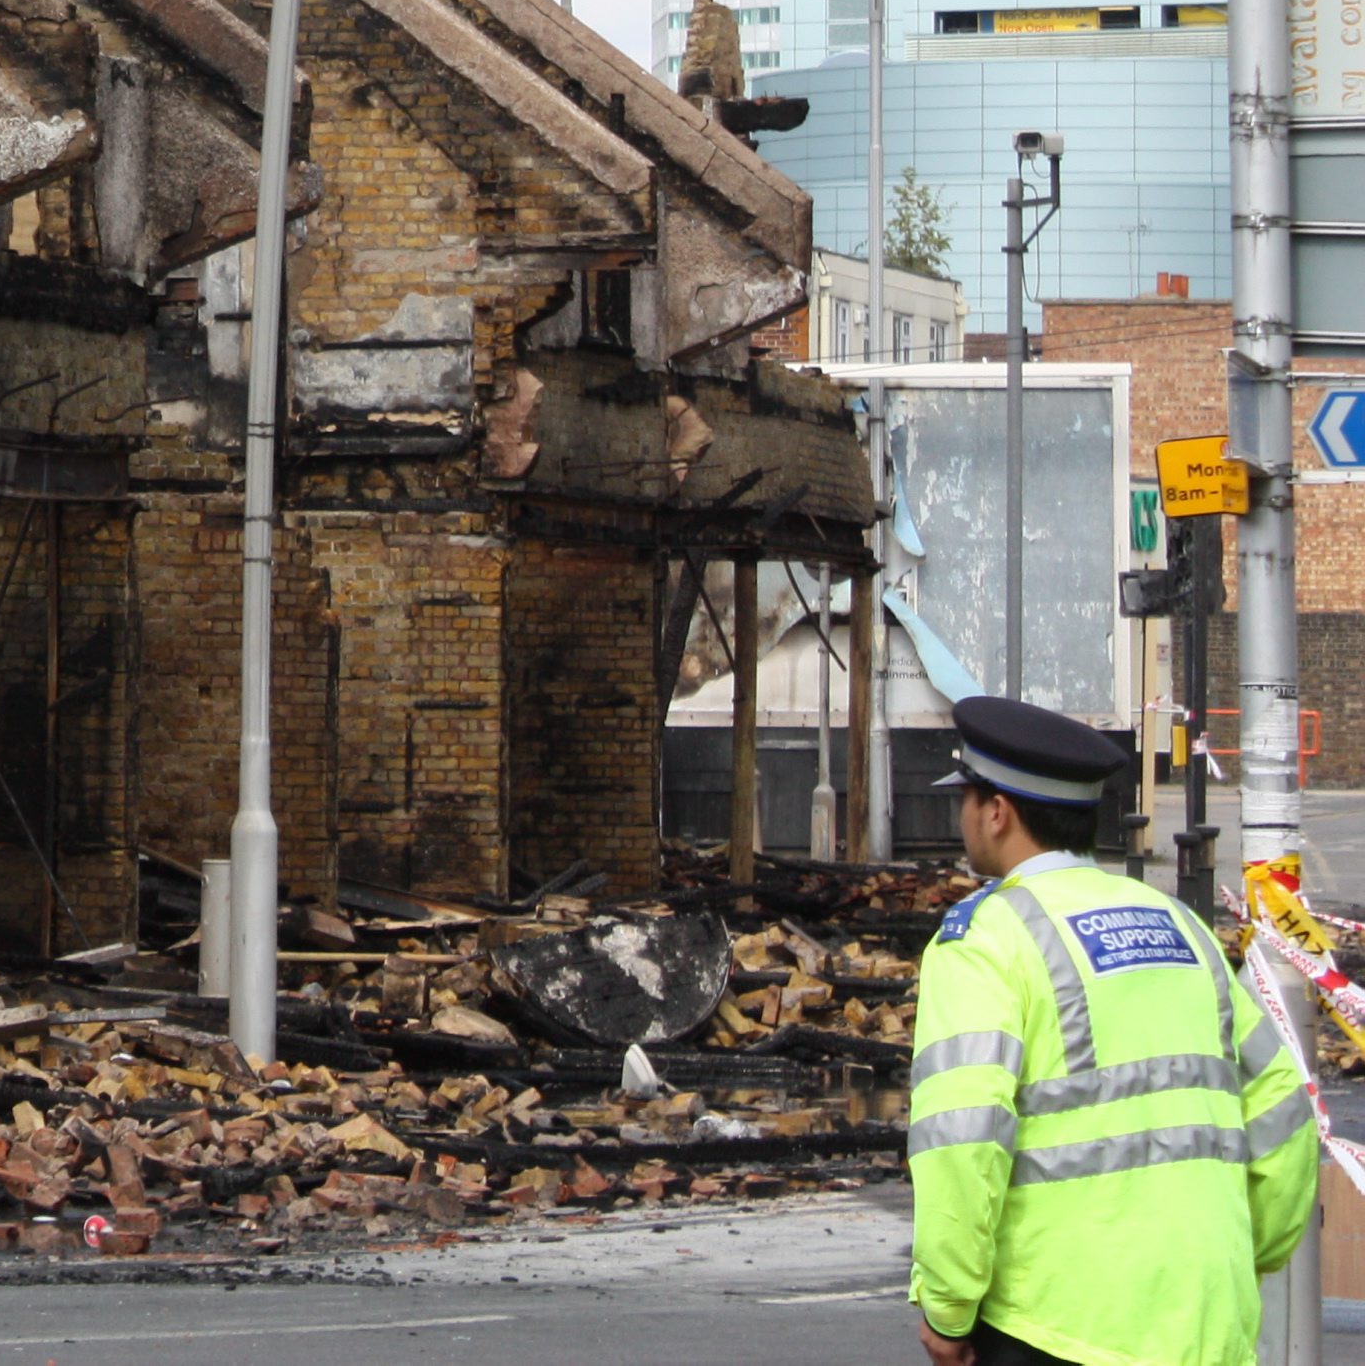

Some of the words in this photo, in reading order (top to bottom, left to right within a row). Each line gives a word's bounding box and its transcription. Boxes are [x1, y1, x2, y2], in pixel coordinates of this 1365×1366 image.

[1166, 487, 1206, 502] 8am
[1077, 911, 1175, 936] COMMUNITY
[1100, 930, 1174, 950] SUPPORT
[1096, 949, 1166, 966] METROPOLITAN
[1167, 949, 1194, 960] POLICE
